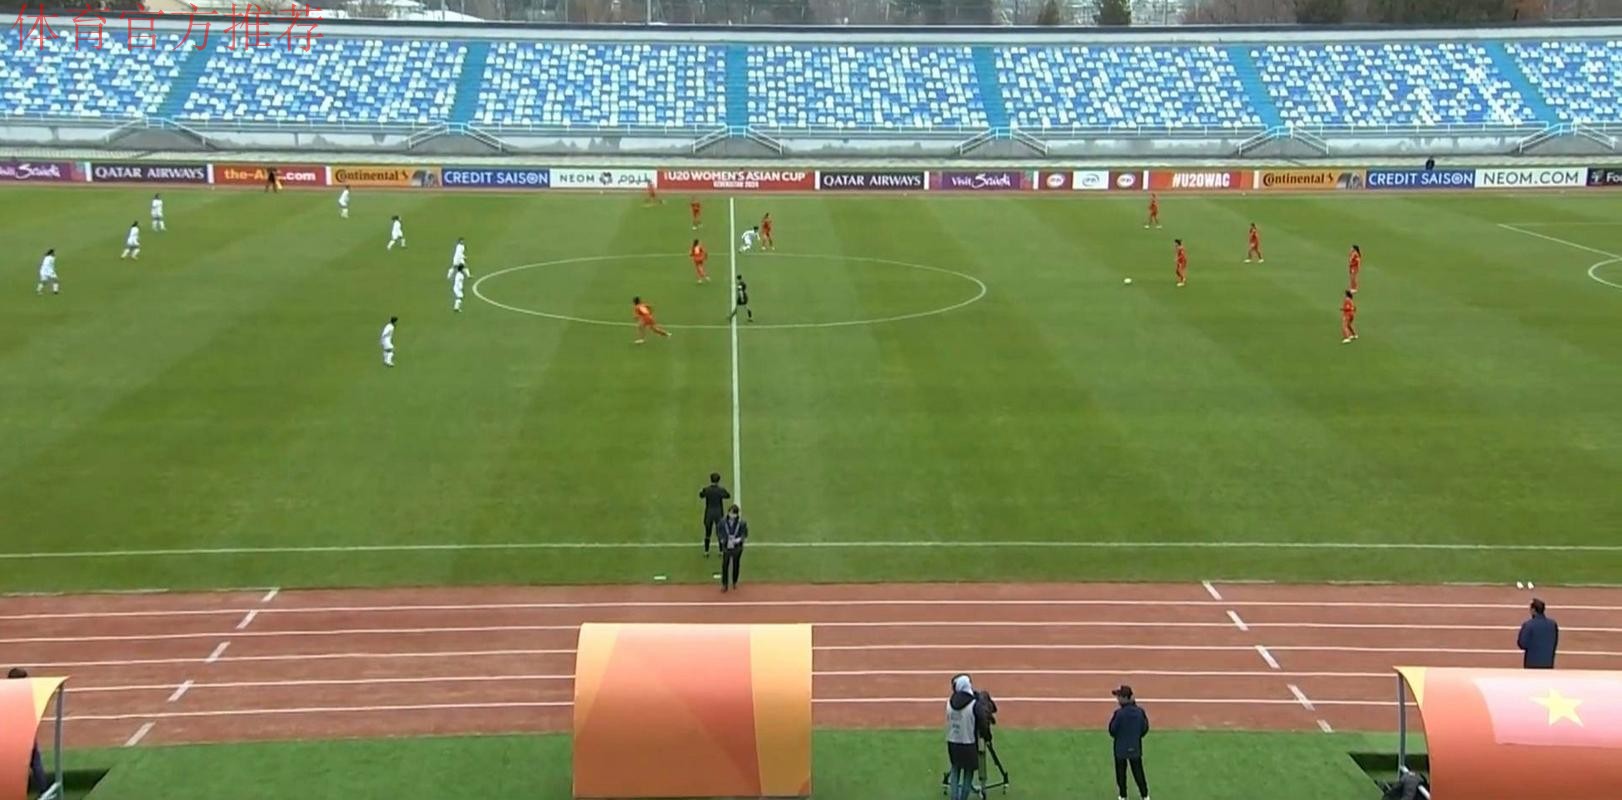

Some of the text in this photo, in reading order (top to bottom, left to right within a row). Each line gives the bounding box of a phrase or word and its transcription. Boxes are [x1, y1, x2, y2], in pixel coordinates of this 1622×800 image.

[95, 166, 205, 180] QATAR AIRWAYS
[224, 168, 316, 181] the-A.com
[335, 169, 399, 182] Continental
[444, 171, 549, 184] CREDIT SAISON
[559, 174, 595, 183] NEOM
[668, 170, 690, 181] U20
[691, 170, 745, 181] WOMEN'S
[746, 170, 782, 181] ASIAN
[782, 171, 806, 181] CUP
[1262, 171, 1325, 186] Continental
[1368, 173, 1474, 185] CREDIT SAISON
[1483, 171, 1579, 185] NEOM.COM
[823, 174, 921, 187] QATAR AIRWAYS
[951, 175, 972, 186] Visit
[1172, 173, 1230, 187] #U20WAC
